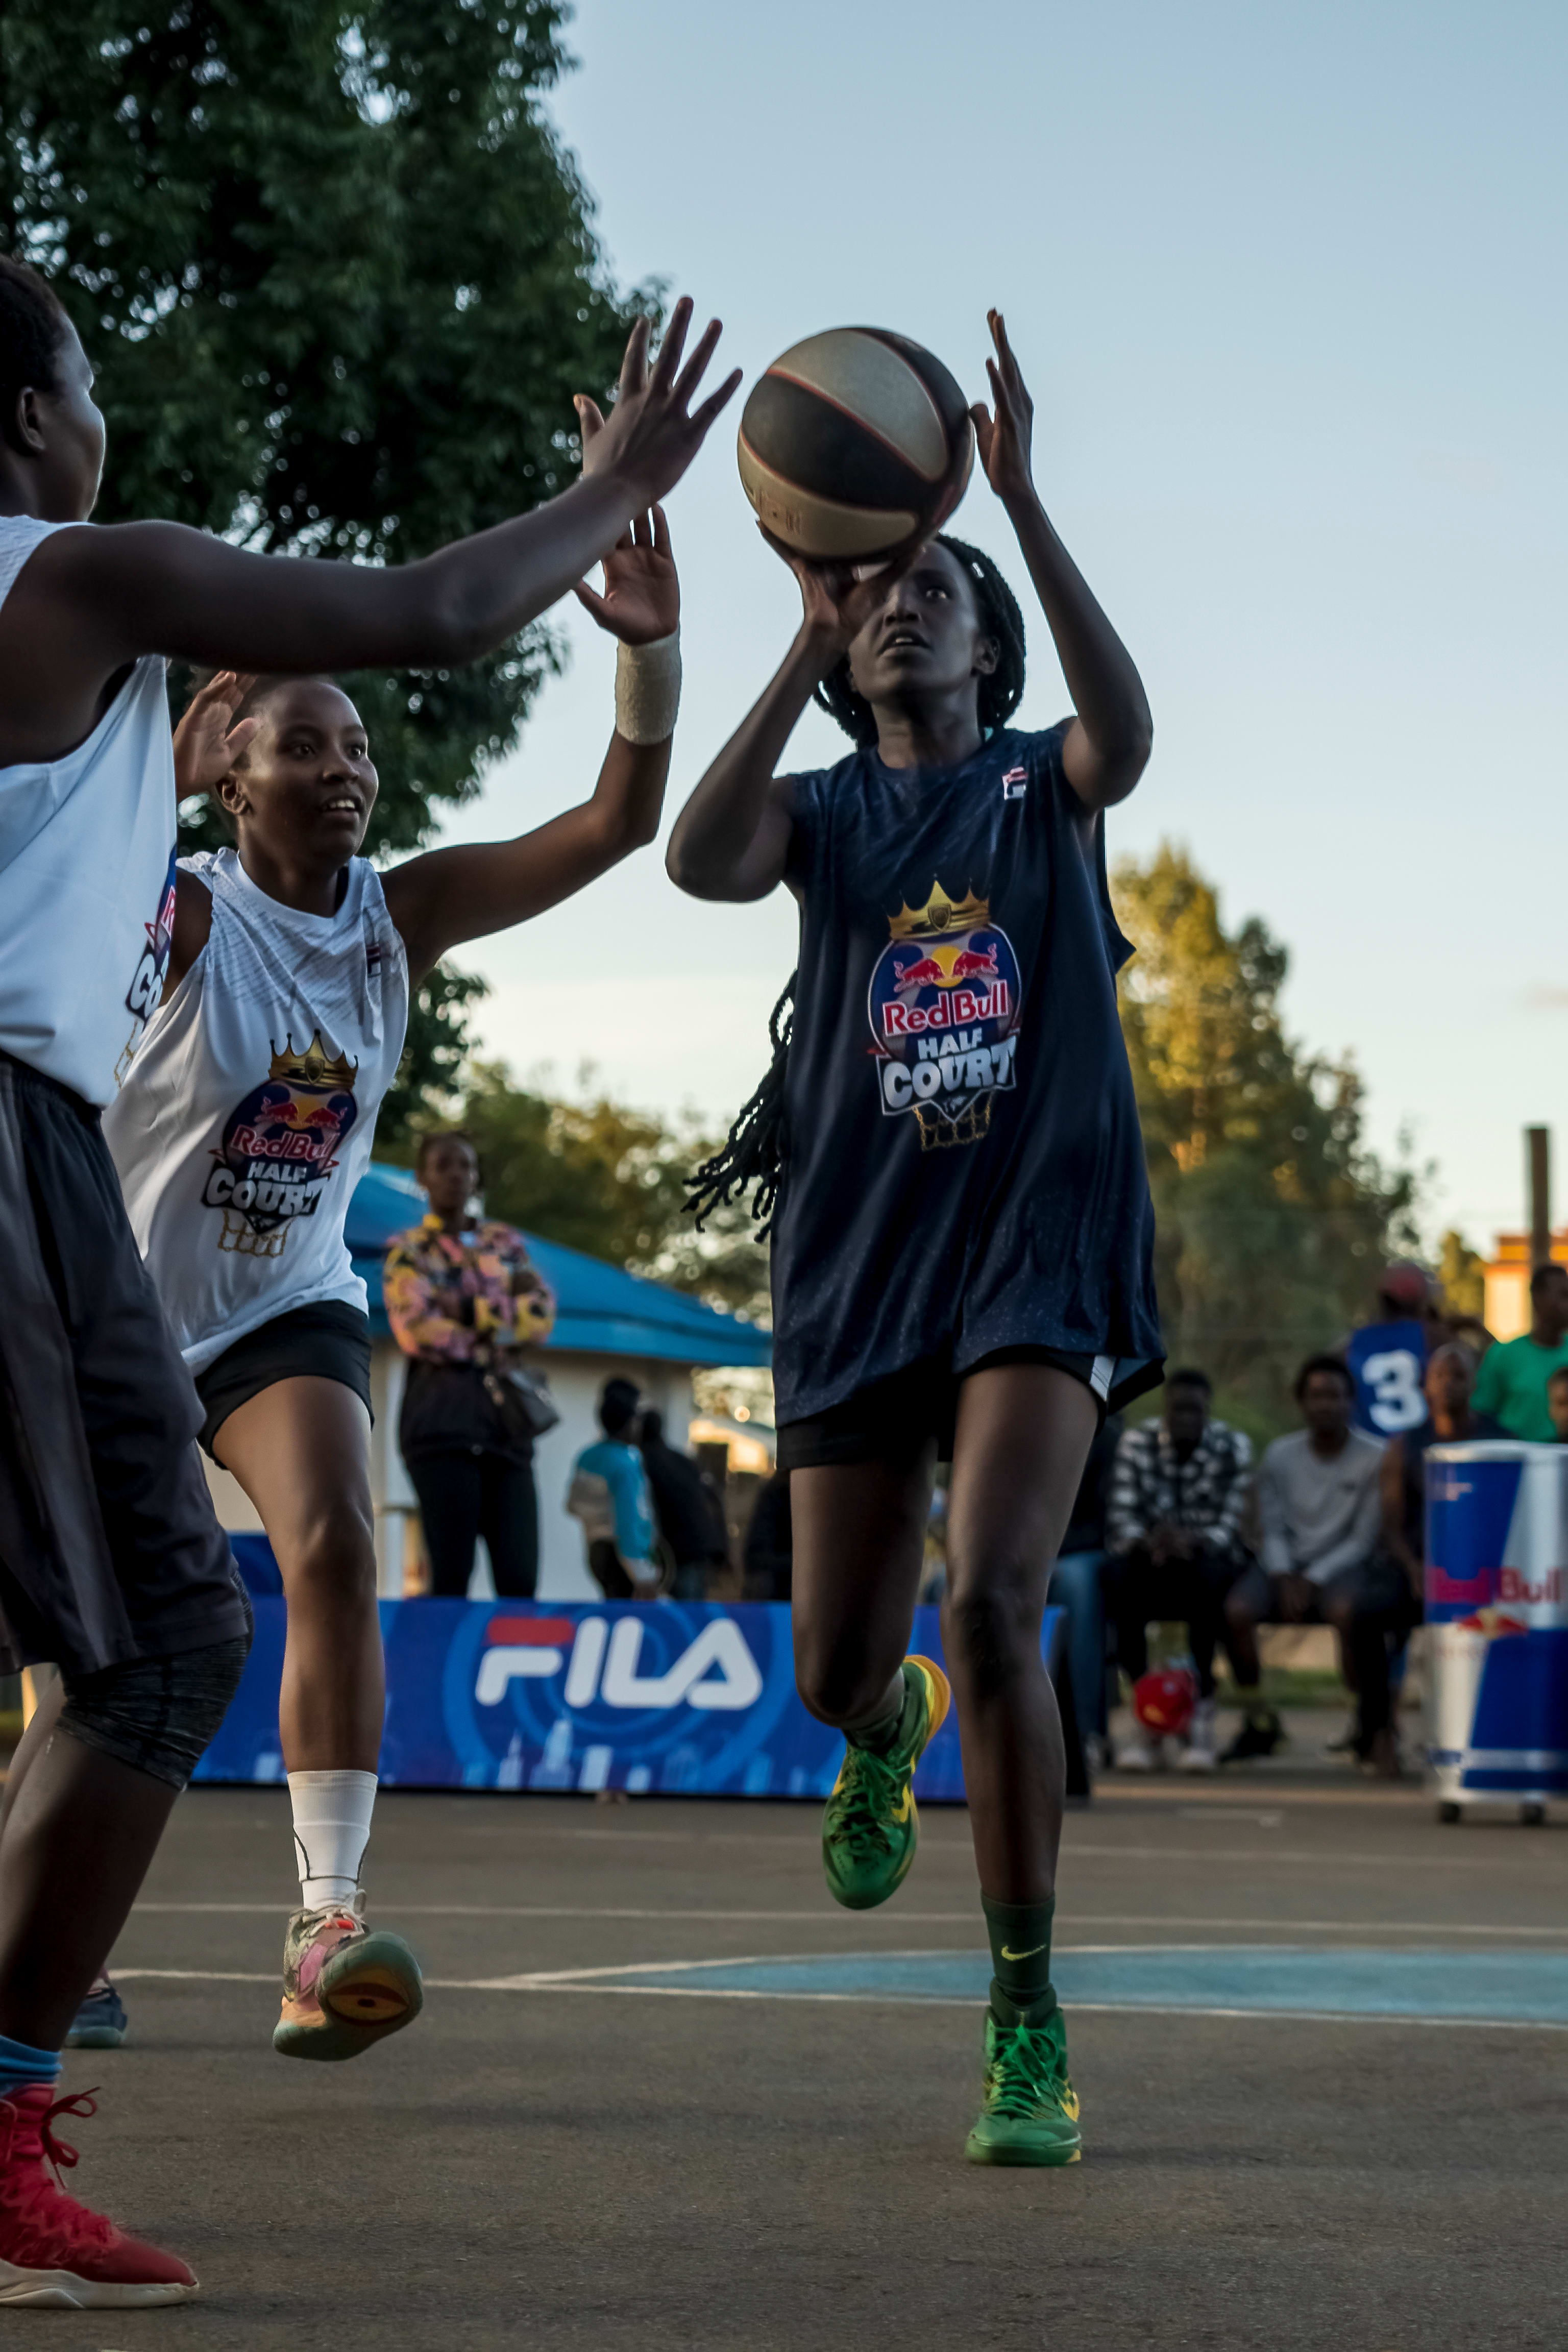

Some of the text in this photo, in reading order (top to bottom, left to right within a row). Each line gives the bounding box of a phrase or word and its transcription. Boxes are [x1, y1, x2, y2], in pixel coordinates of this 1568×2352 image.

[883, 979, 1009, 1035] Red Bull
[918, 1027, 982, 1060] HALF
[884, 1035, 1016, 1108] COURT
[231, 1125, 292, 1157] Red
[206, 1167, 328, 1215] COURT
[248, 1162, 307, 1183] HALF
[1361, 1348, 1428, 1431] 3
[475, 1615, 763, 1710] FILA
